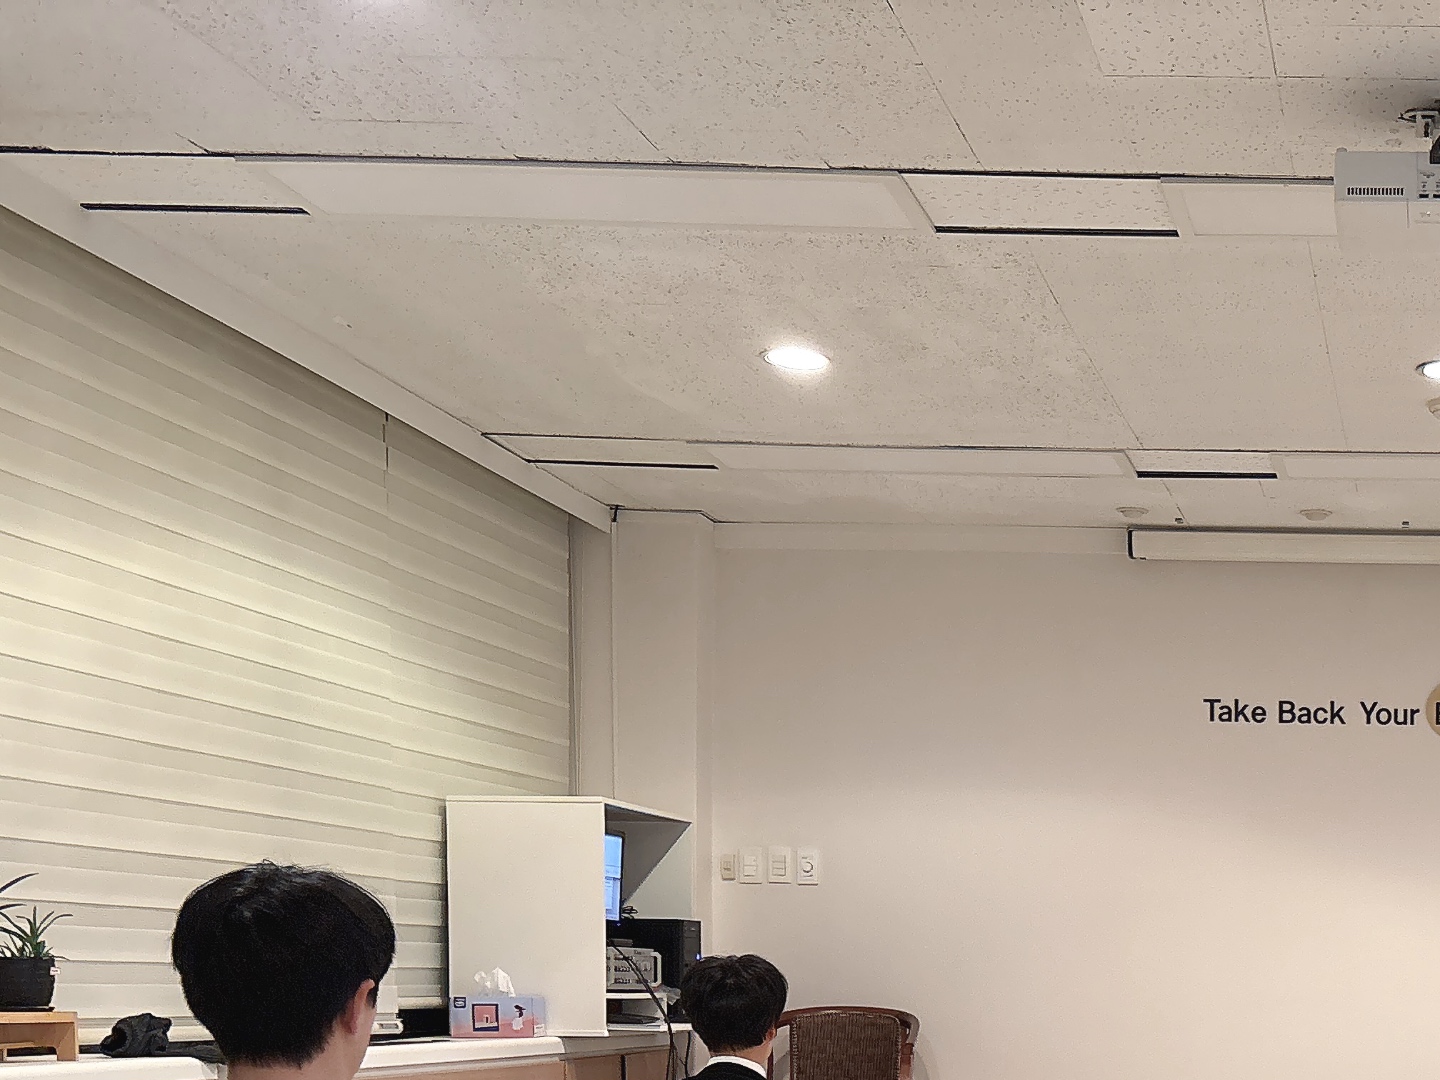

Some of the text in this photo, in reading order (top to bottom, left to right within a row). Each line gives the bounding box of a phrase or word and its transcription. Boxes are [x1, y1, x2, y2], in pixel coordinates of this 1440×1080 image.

[1202, 698, 1267, 724] Take
[1278, 700, 1347, 725] Back
[1359, 701, 1420, 726] Your
